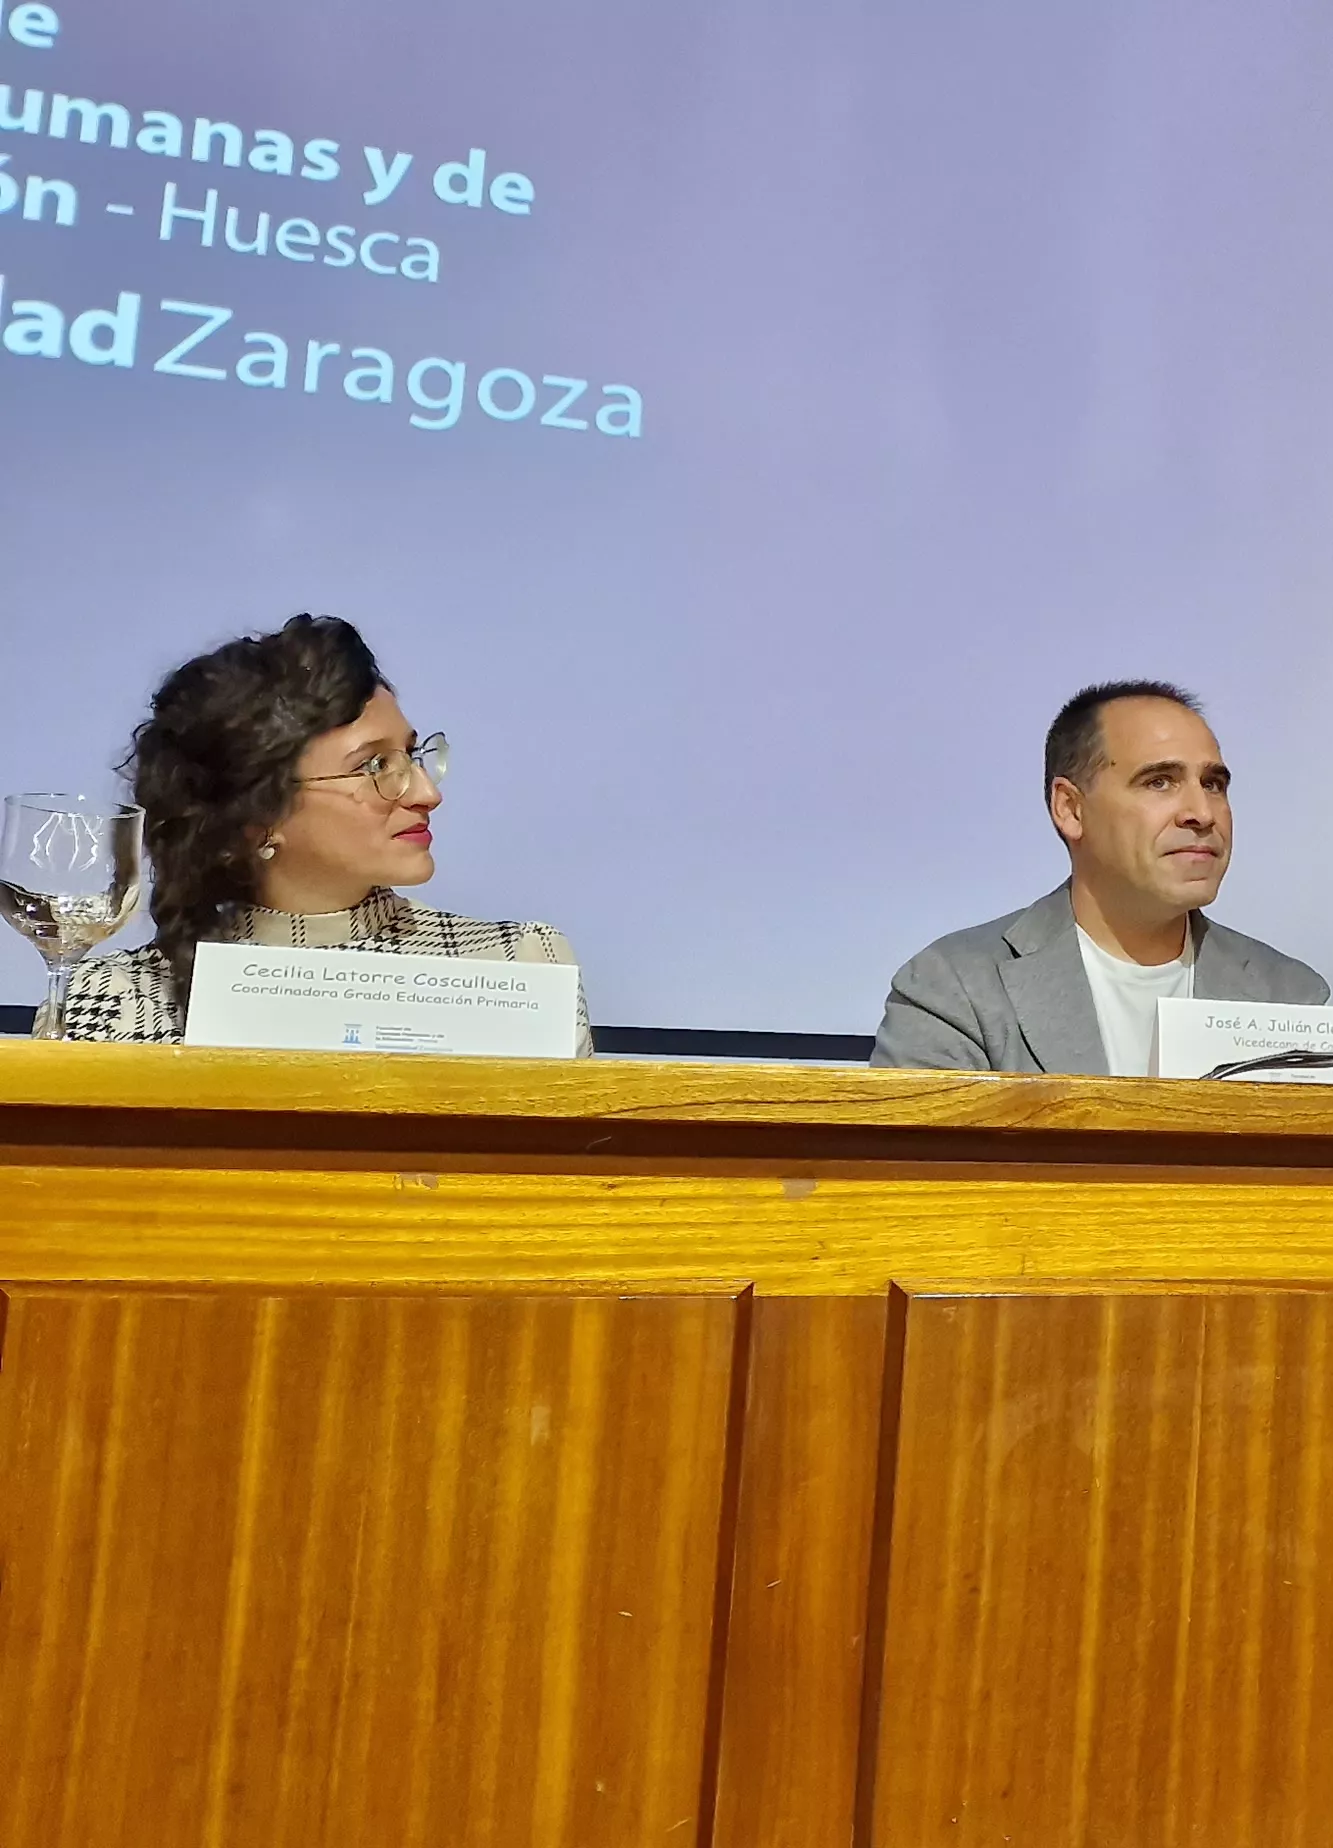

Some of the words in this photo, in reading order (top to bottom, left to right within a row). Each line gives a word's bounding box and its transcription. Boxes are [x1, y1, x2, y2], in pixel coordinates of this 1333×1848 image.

[0, 2, 60, 48] e
[363, 145, 413, 205] y
[432, 149, 536, 215] de
[159, 182, 441, 283] Huesca
[0, 274, 141, 369] ad
[231, 983, 338, 998] Coordinadora
[343, 988, 391, 1001] Grado
[397, 990, 473, 1006] Educación
[477, 996, 539, 1010] Primaria
[242, 963, 315, 980] Cecilia
[322, 966, 406, 986] Latorre
[413, 972, 527, 993] Cosculluela
[1205, 1015, 1241, 1030] José
[1247, 1018, 1262, 1031] A.
[1267, 1018, 1312, 1034] Julián
[1302, 1040, 1316, 1050] de
